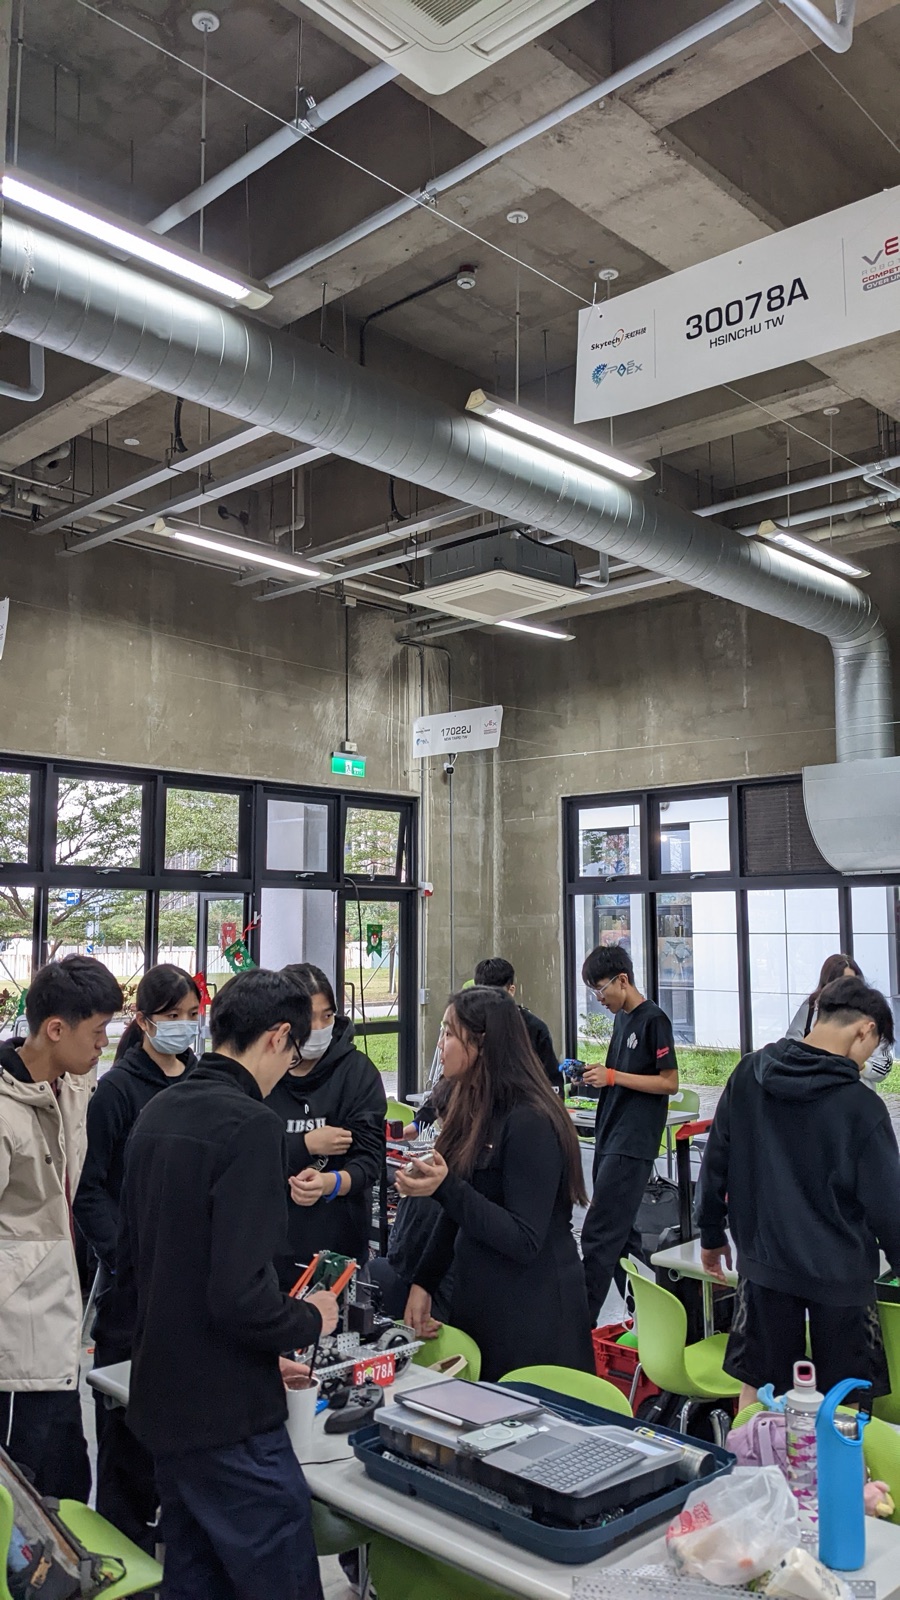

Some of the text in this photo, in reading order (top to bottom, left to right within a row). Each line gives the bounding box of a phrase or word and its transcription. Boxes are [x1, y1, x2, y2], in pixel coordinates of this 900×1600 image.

[866, 278, 889, 290] OVER
[685, 277, 809, 340] 30078A
[709, 314, 785, 349] HSINCHU TW
[590, 336, 621, 351] Skytech
[440, 724, 472, 737] 17022J
